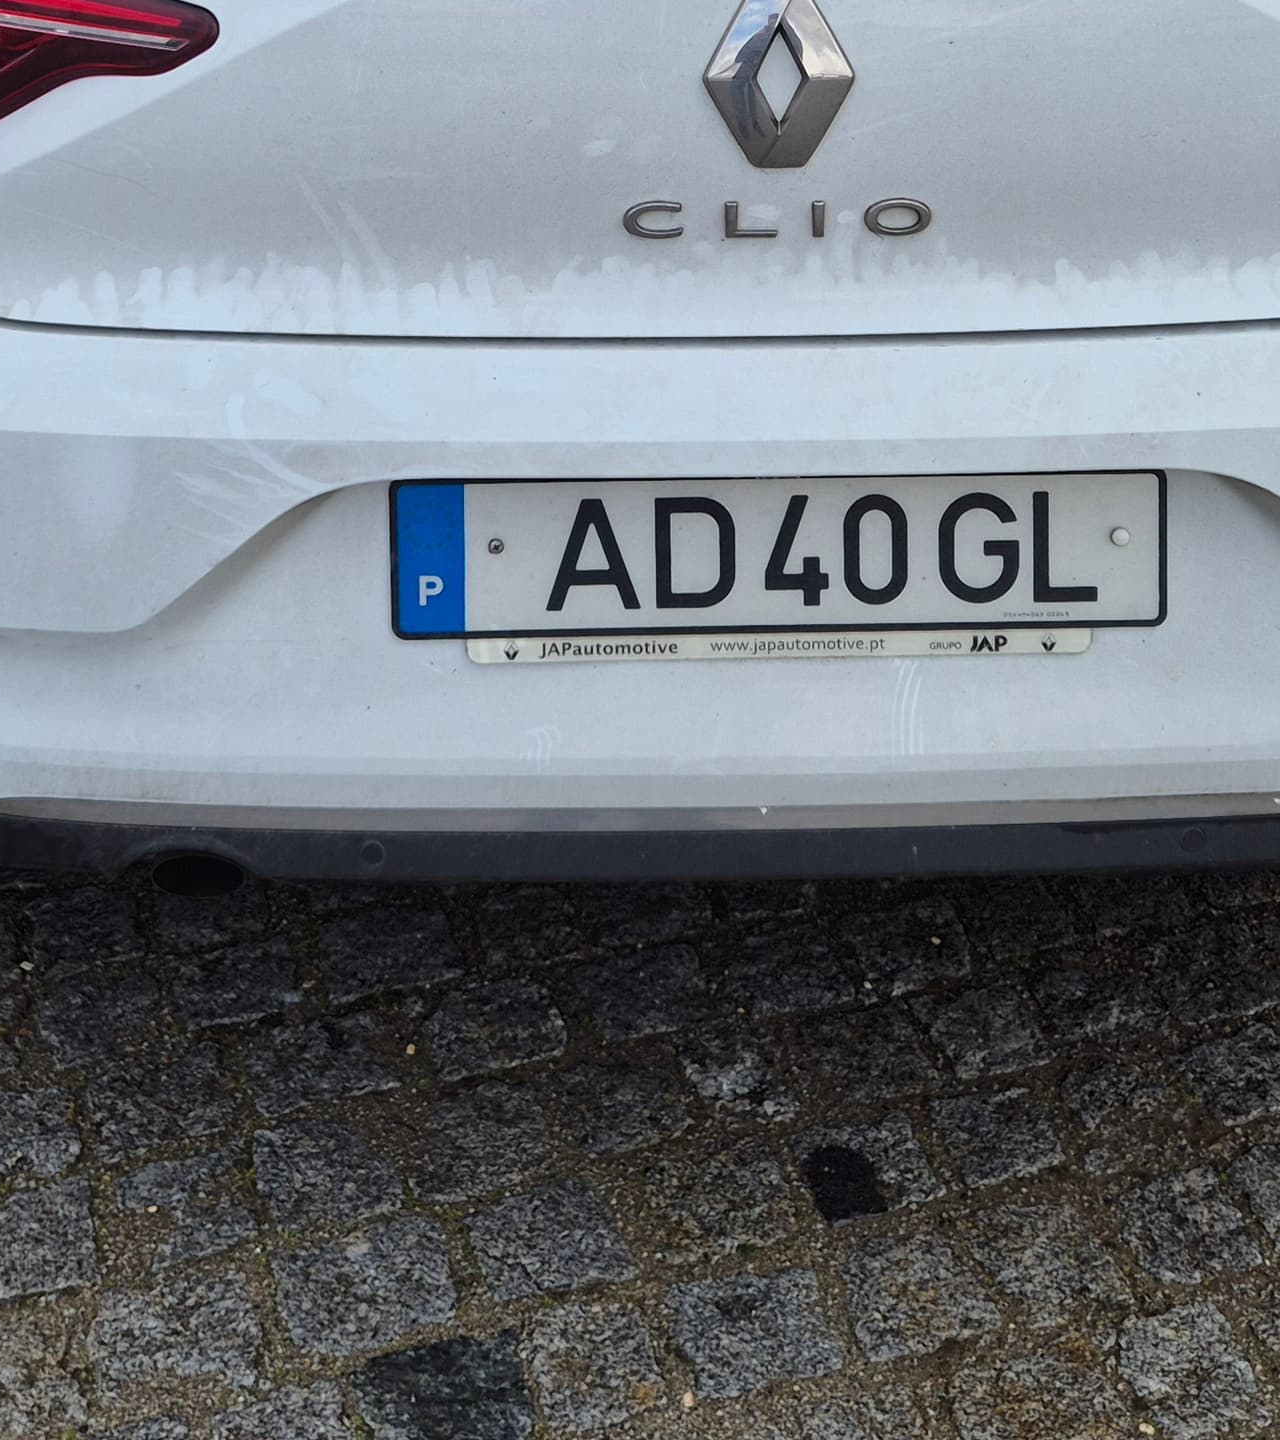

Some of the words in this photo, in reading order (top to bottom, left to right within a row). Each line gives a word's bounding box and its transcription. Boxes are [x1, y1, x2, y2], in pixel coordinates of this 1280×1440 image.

[623, 197, 932, 239] CLIO
[419, 575, 445, 606] P
[539, 641, 679, 659] JAPautomotive
[710, 637, 886, 654] www.japautomotive.pt
[929, 641, 963, 650] GRUPO
[970, 635, 1009, 653] JAP
